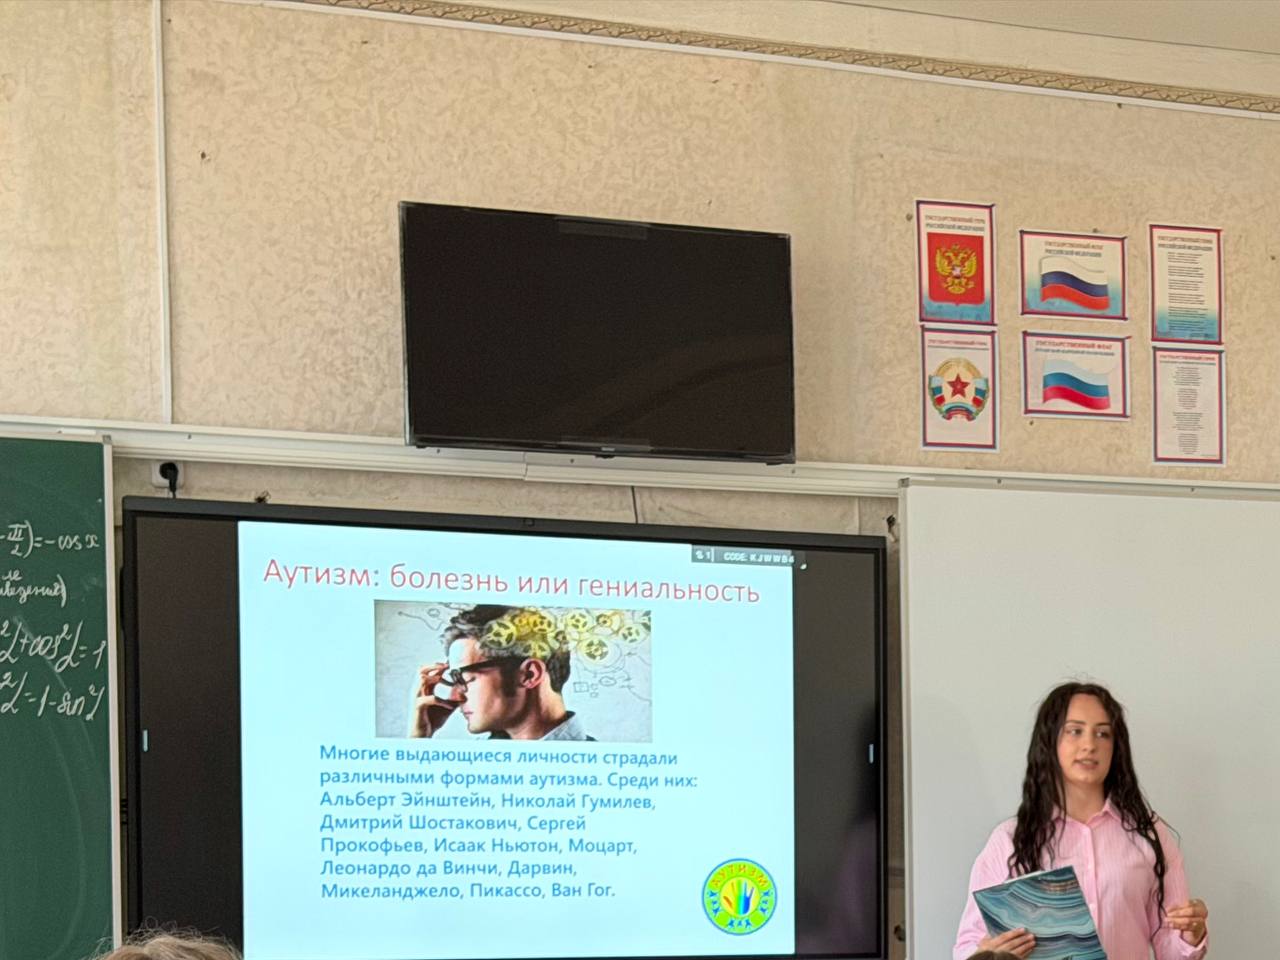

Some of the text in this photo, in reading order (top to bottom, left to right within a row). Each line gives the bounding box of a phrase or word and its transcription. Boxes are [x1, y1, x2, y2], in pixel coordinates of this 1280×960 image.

[264, 559, 760, 602] Аутизм: болезнь или гениальность
[319, 745, 678, 768] Многие выдающиеся личности страдали
[320, 770, 698, 790] различными формами аутизма. Среди них:
[320, 791, 656, 812] Альберт Эйнштейн, Николай Гумилев,
[320, 814, 586, 833] Дмитрий Шостакович, Сергей
[321, 837, 637, 856] Прокофьев, Исаак Ньютон, Моцарт,
[320, 860, 577, 878] Леонардо да Винчи, Дарвин,
[321, 882, 616, 900] Микеланджело, Пикассо, Ван Гог.
